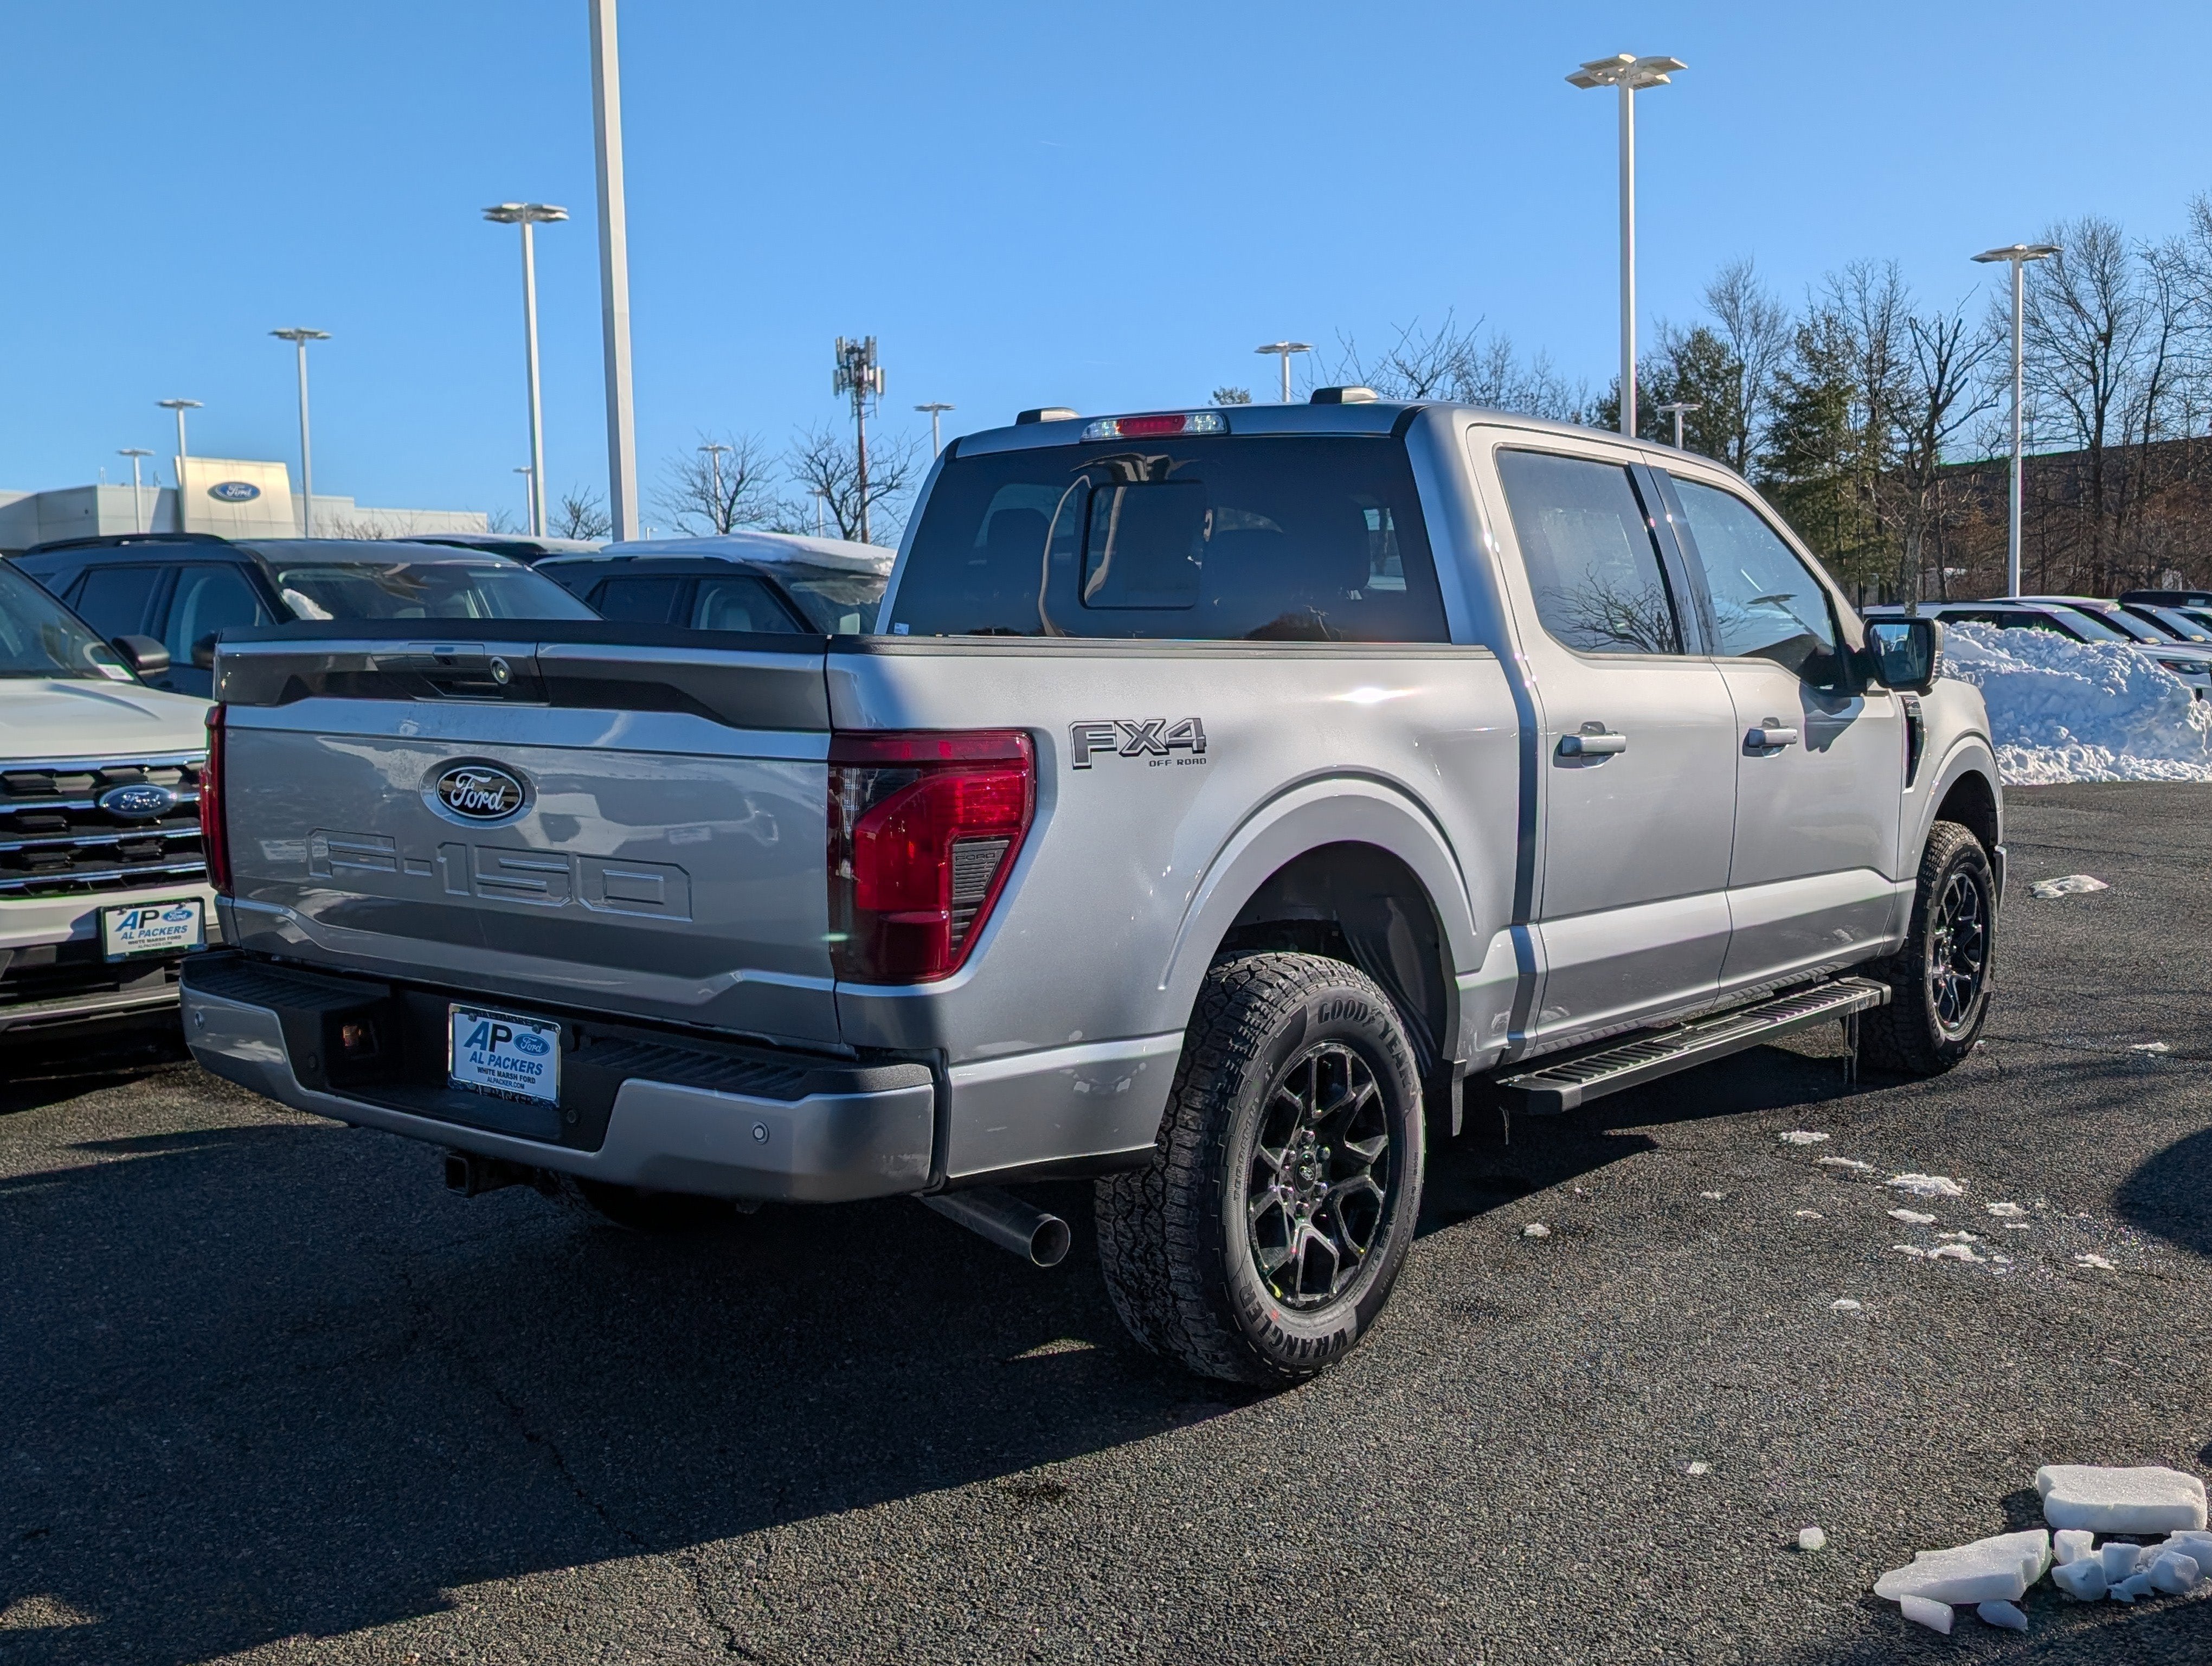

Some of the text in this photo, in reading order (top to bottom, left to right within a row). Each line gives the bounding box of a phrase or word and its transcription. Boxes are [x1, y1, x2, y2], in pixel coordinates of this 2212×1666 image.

[227, 483, 252, 497] Ford
[1069, 717, 1207, 770] FX4
[121, 791, 160, 810] Ford
[451, 767, 506, 811] Ford
[955, 853, 995, 862] FORD
[306, 828, 693, 923] F-150
[115, 909, 159, 932] AP
[121, 925, 188, 940] AL PACKERS
[464, 1021, 543, 1053] AP Ford
[1317, 999, 1413, 1089] GOODYEAR
[470, 1051, 543, 1076] AL PACKERS
[477, 1066, 536, 1085] WHITE MARSH FORD
[1239, 1280, 1348, 1360] WRANGLER
